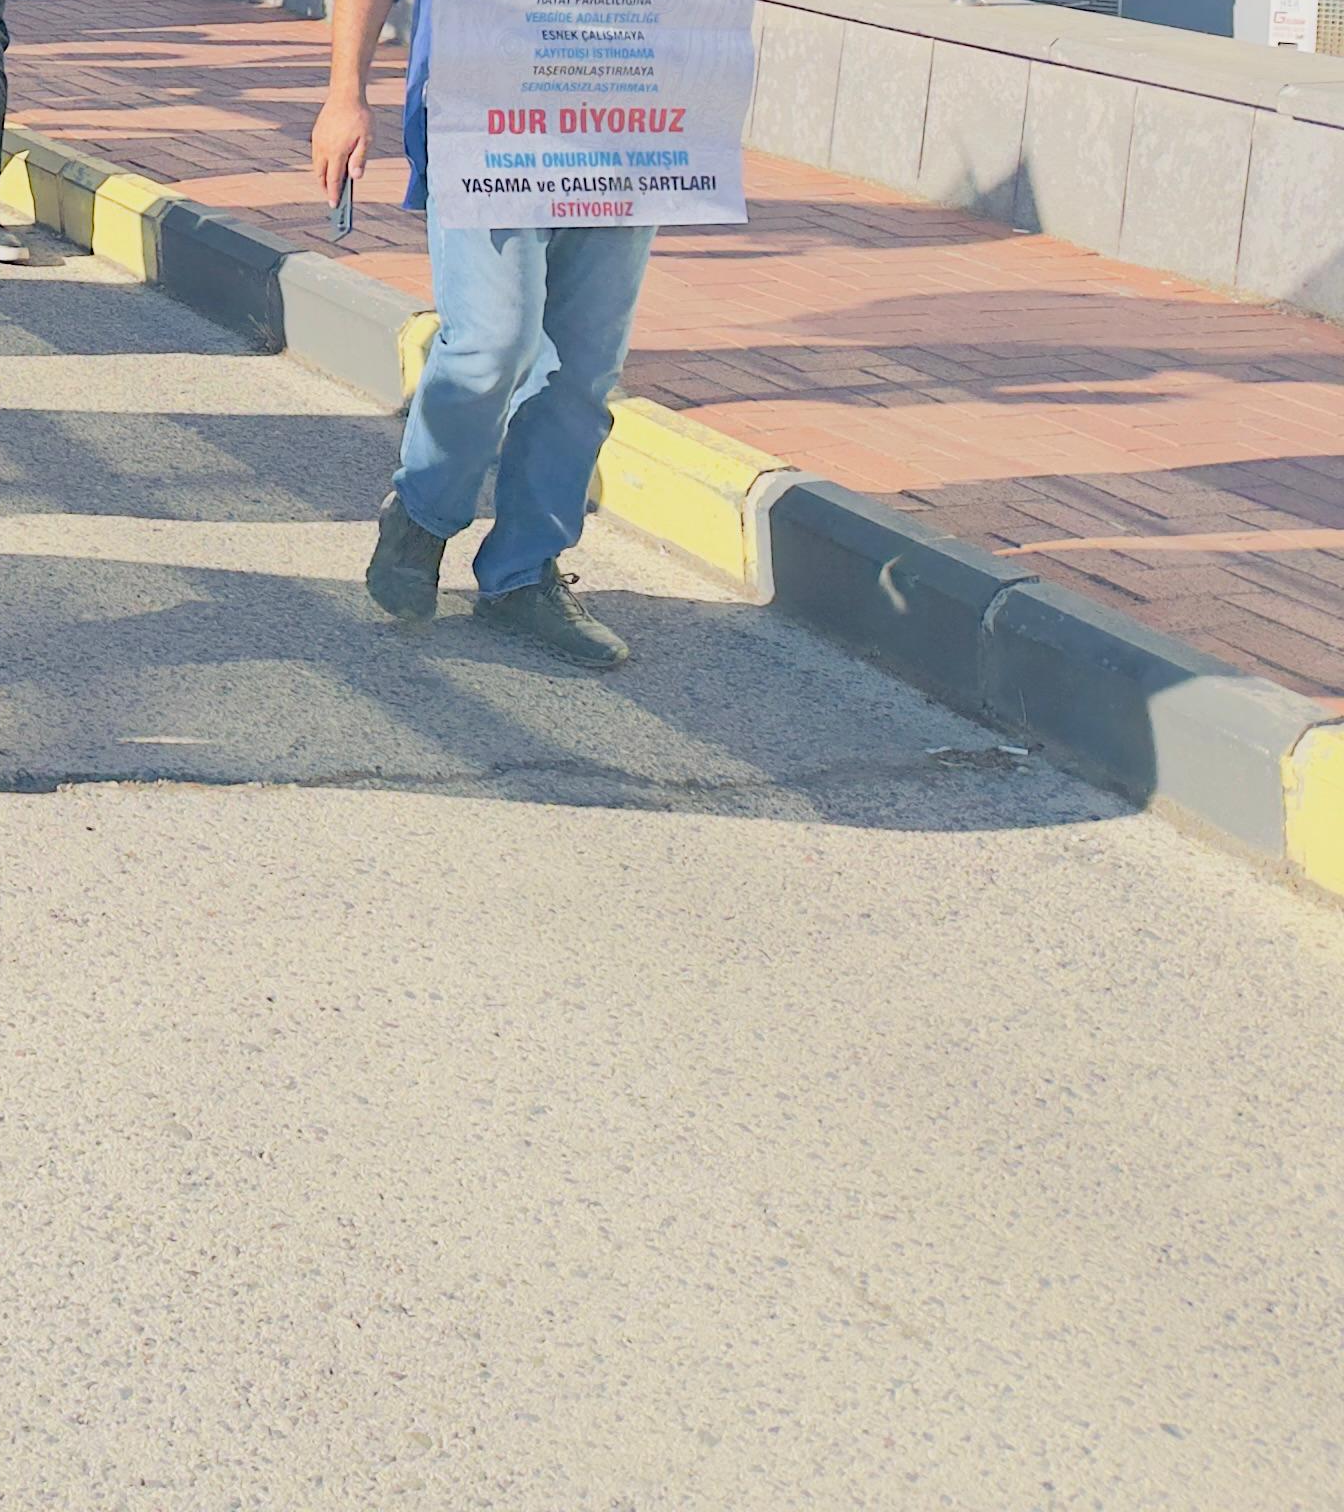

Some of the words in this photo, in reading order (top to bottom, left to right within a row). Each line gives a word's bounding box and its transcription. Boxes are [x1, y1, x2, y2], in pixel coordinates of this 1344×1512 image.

[542, 30, 578, 41] ESNEK
[487, 108, 547, 135] DUR
[560, 102, 687, 134] DİYORUZ
[485, 150, 537, 169] İNSAN
[542, 151, 623, 168] ONURUNA
[628, 150, 689, 171] YAKIŞIR
[462, 178, 532, 197] YAŞAMA
[537, 180, 556, 193] ve
[561, 177, 634, 196] ÇALIŞMA
[639, 175, 717, 196] ŞARTLARI
[551, 199, 635, 218] İSTİYORUZ
